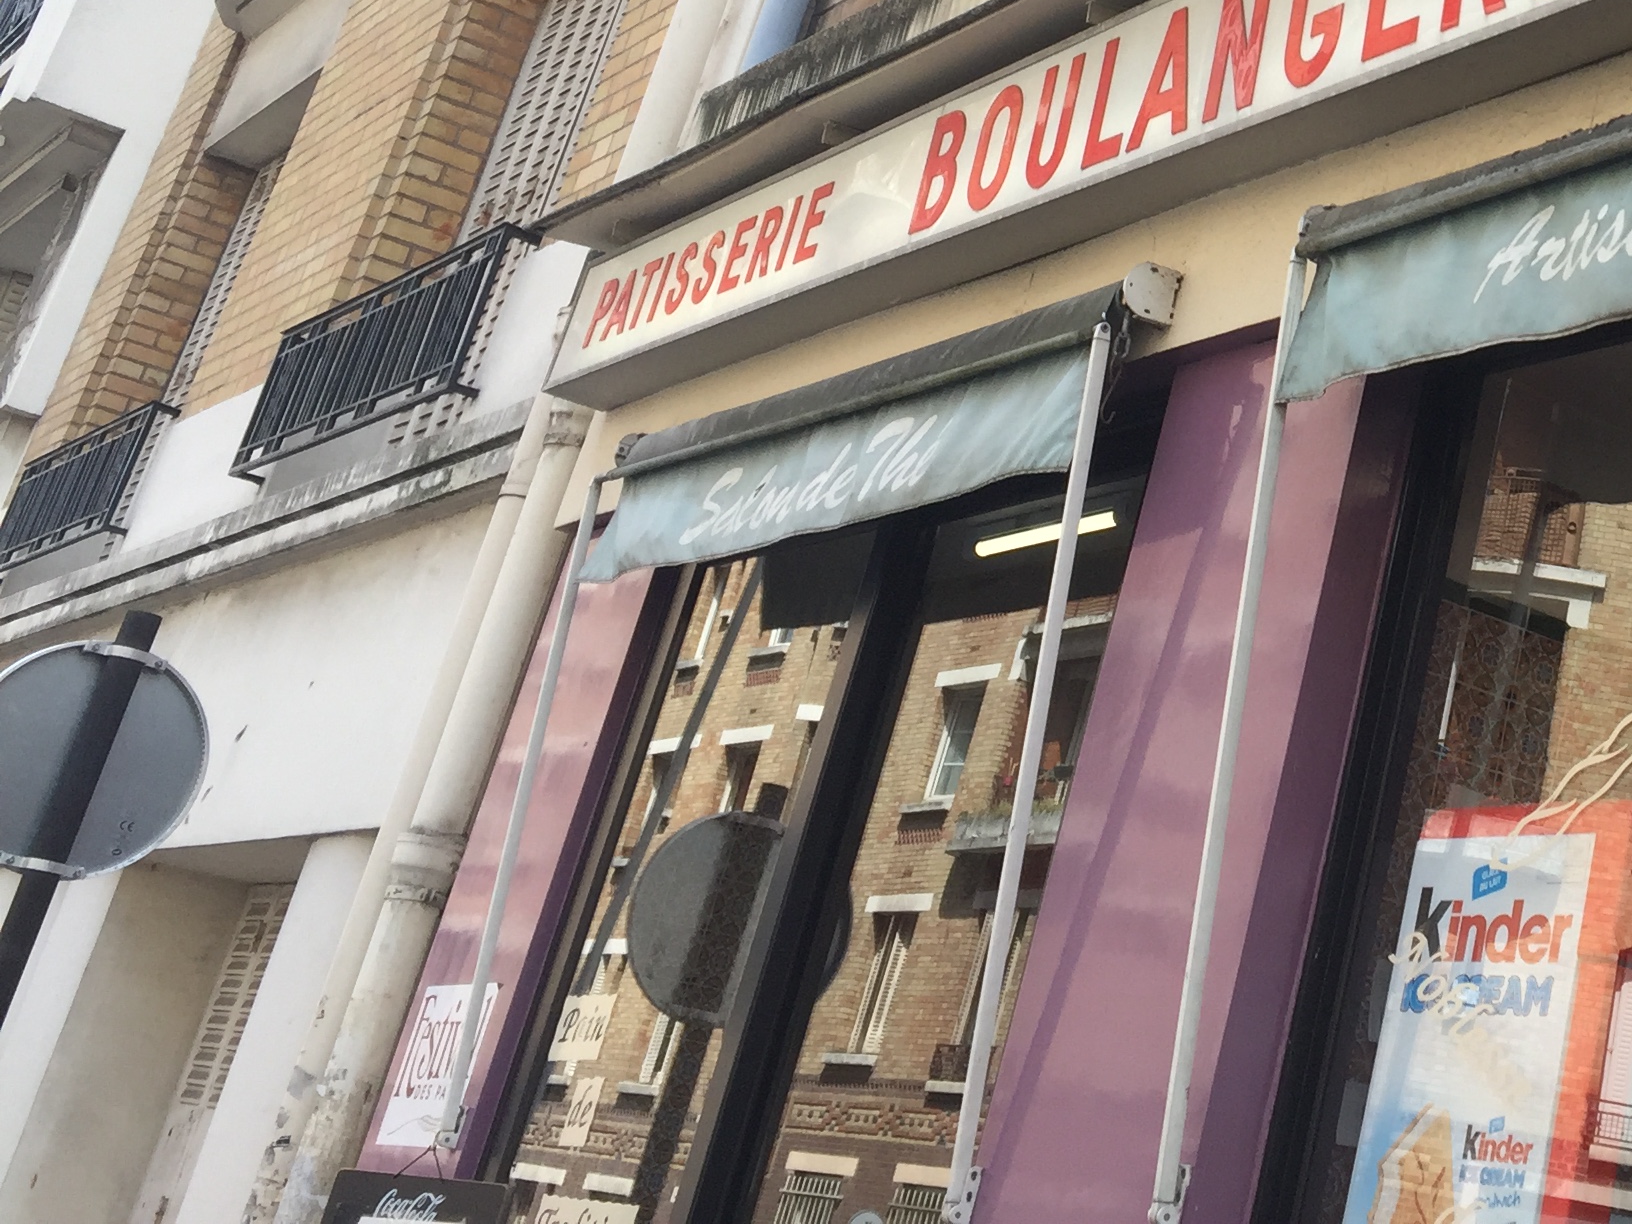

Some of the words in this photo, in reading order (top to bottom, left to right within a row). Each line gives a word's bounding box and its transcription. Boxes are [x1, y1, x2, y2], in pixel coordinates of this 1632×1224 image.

[582, 181, 836, 350] PATISSERIE
[678, 466, 800, 546] Salon
[796, 442, 858, 512] de
[557, 1005, 608, 1045] Pain
[566, 1084, 593, 1129] de
